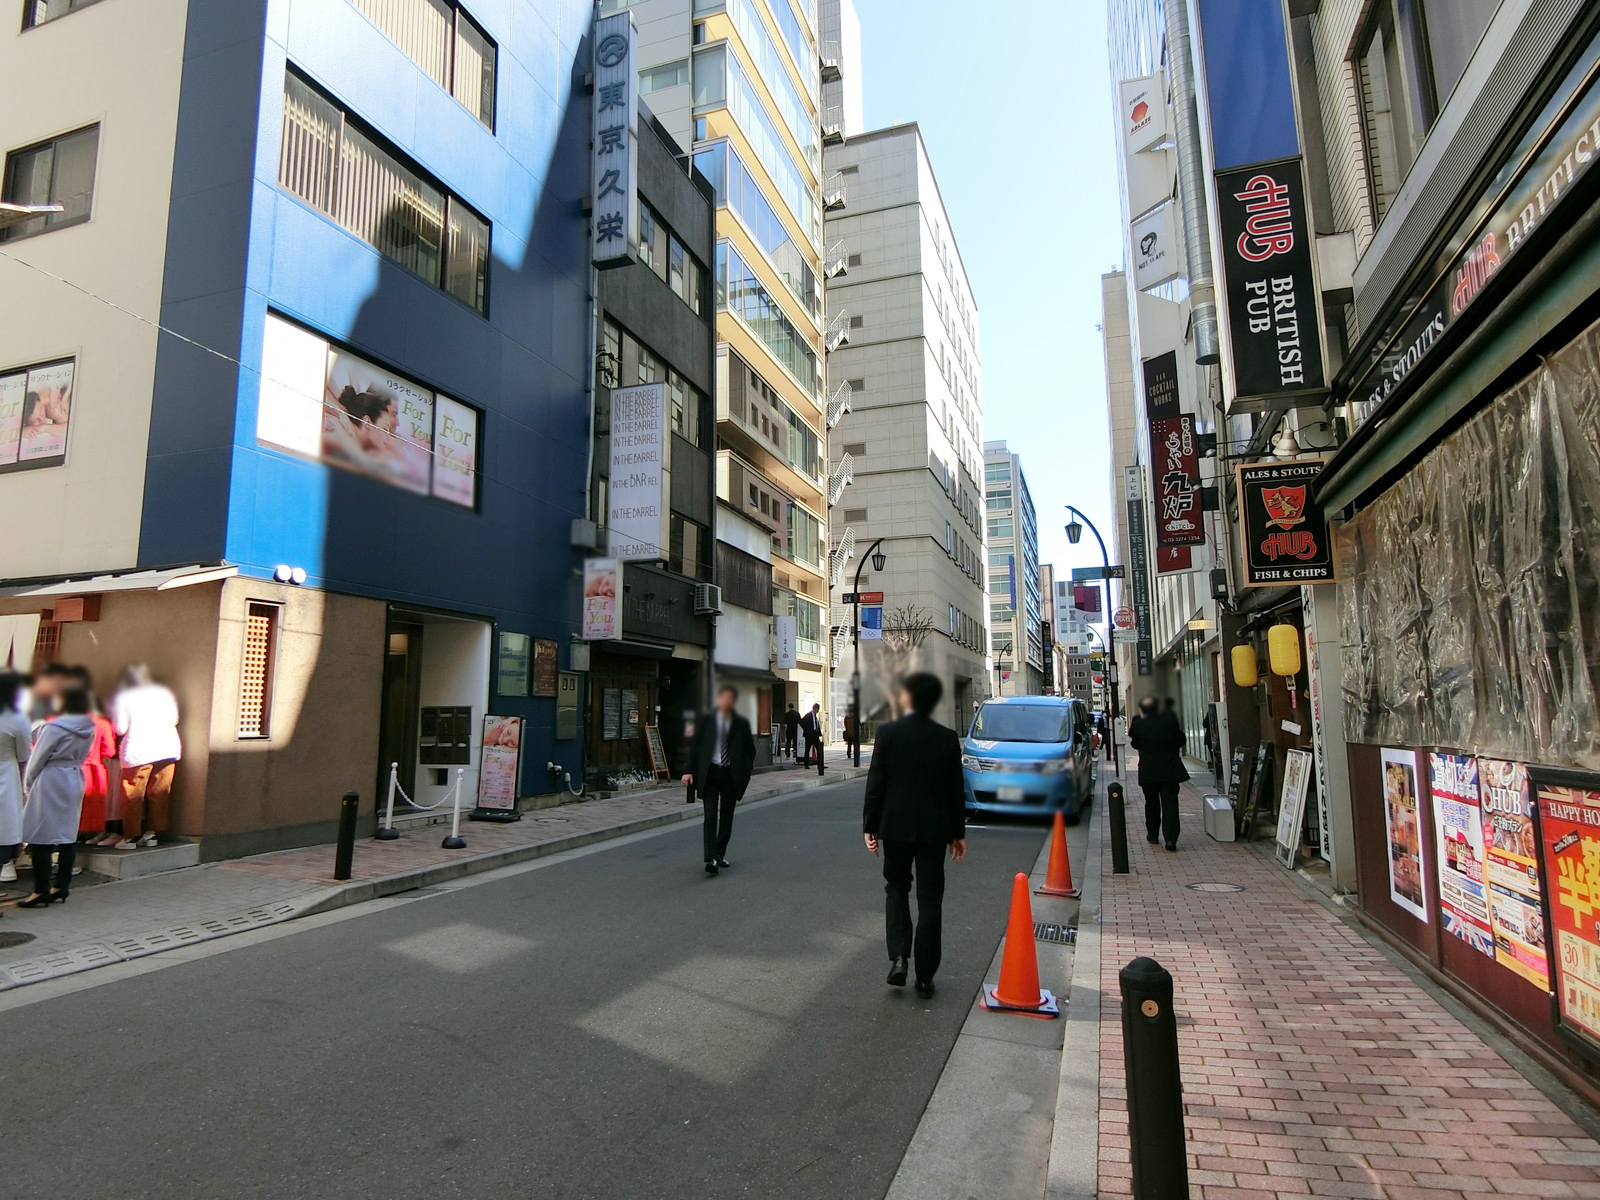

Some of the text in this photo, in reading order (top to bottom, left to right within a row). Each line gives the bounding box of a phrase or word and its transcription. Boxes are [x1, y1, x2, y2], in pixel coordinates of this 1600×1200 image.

[597, 81, 626, 243] 東京久栄
[1233, 174, 1294, 263] HUB
[1245, 278, 1271, 334] PUB
[1271, 275, 1304, 386] BRITISH
[402, 399, 425, 421] For
[410, 421, 433, 444] You
[439, 415, 472, 446] For
[621, 422, 633, 432] THE
[635, 419, 659, 431] BARREL
[614, 433, 659, 447] IN THE BARREL
[438, 443, 471, 476] You
[614, 451, 659, 465] IN THE BARREL
[630, 473, 647, 488] BAR
[1244, 470, 1270, 479] ALES
[1281, 466, 1321, 477] STOUTS
[612, 505, 658, 519] IN THE BARREL
[619, 545, 631, 555] THE
[632, 542, 657, 555] BARREL
[1261, 531, 1317, 561] HUB
[1112, 569, 1123, 577] 23
[1255, 568, 1327, 579] FISH & CHIPS
[586, 599, 608, 611] For
[589, 612, 612, 624] You
[1491, 787, 1522, 815] HUB
[1549, 802, 1581, 822] HAPPY
[1564, 943, 1579, 967] 30
